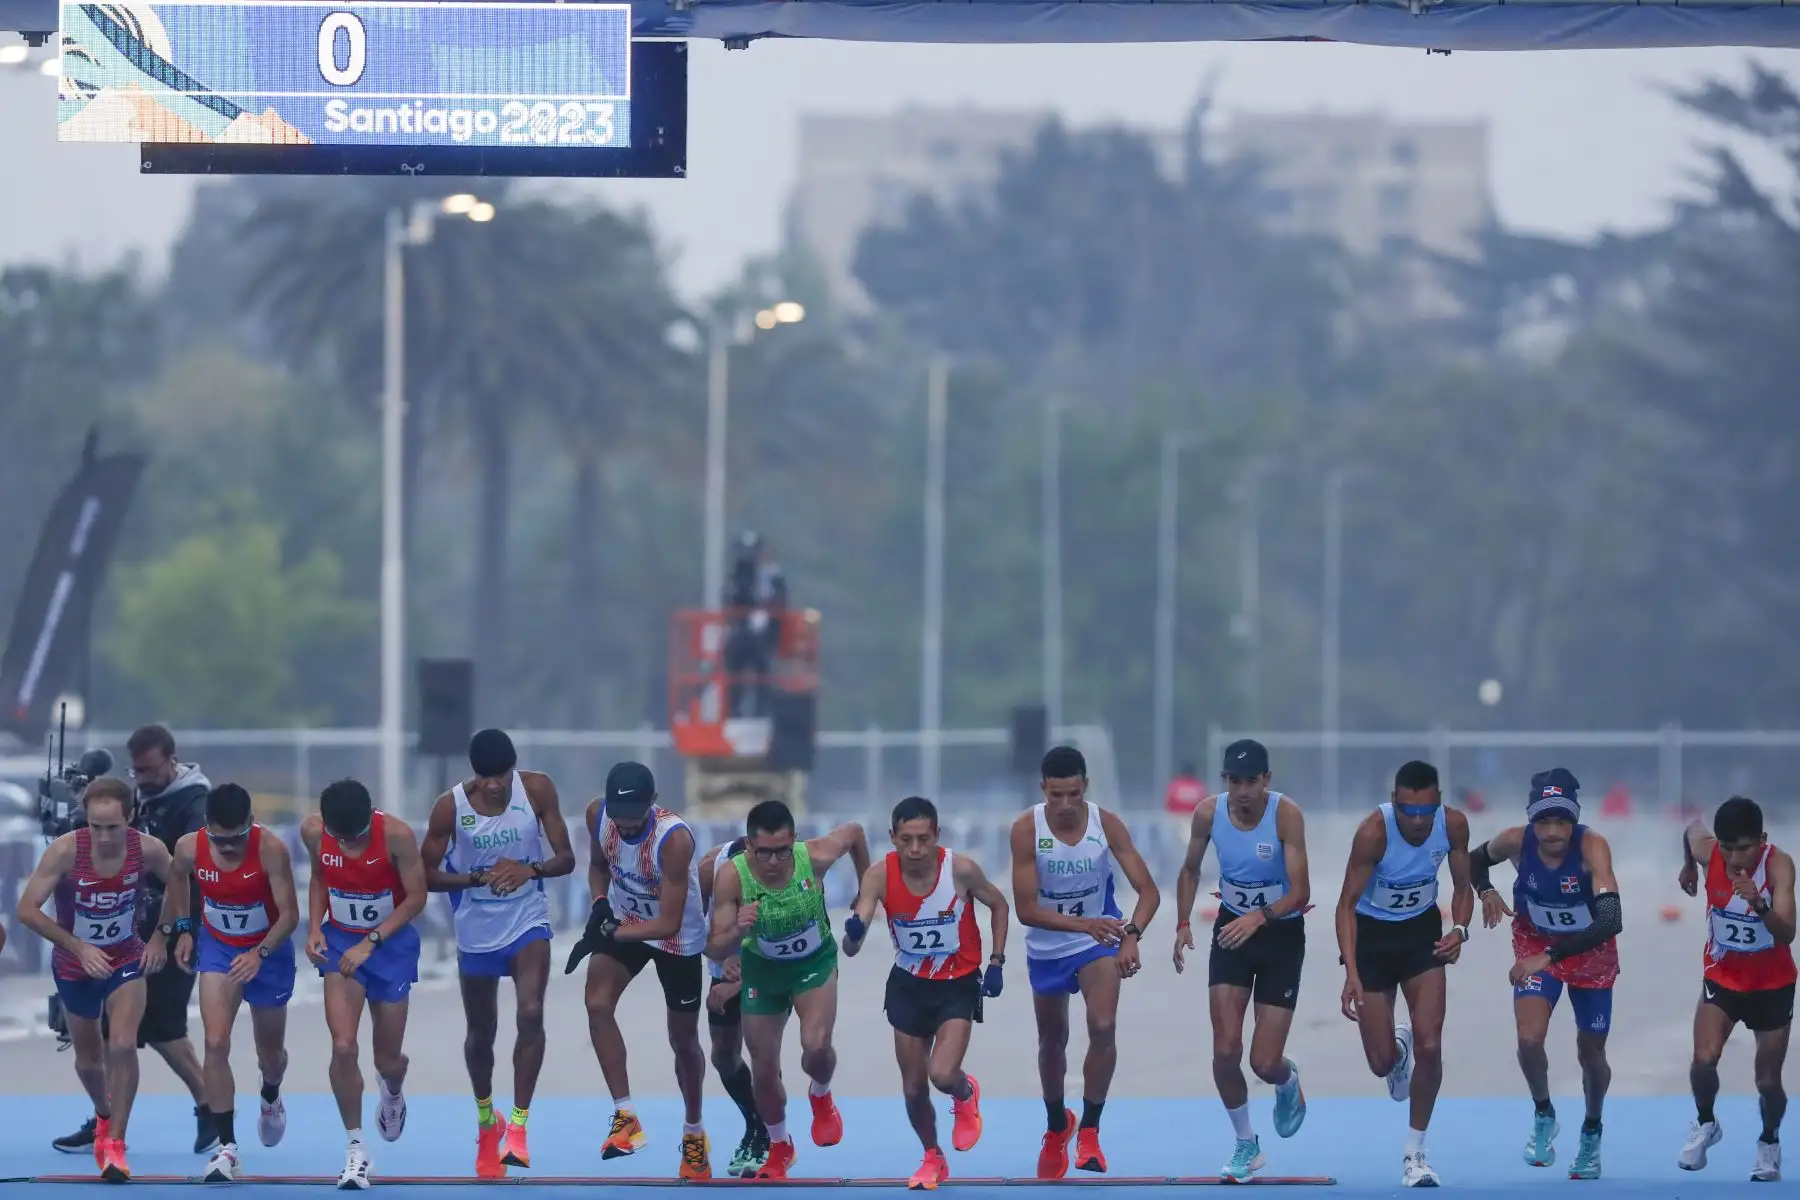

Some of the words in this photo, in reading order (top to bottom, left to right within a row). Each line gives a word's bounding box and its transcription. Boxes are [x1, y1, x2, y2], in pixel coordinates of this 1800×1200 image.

[317, 11, 367, 86] 0
[323, 100, 498, 141] Santiago
[500, 101, 614, 144] 2023
[472, 827, 522, 850] BRASIL
[322, 853, 343, 868] CHI
[1047, 857, 1096, 875] BRASIL
[197, 868, 219, 883] CHI
[75, 888, 136, 909] USA
[627, 897, 654, 917] 21
[1235, 891, 1268, 909] 24
[1387, 890, 1421, 908] 25
[349, 903, 379, 922] 16
[1057, 901, 1085, 917] 14
[221, 913, 249, 930] 17
[1545, 910, 1577, 927] 18
[89, 921, 121, 940] 26
[908, 929, 945, 949] 22
[1725, 923, 1757, 944] 23
[774, 938, 808, 956] 20
